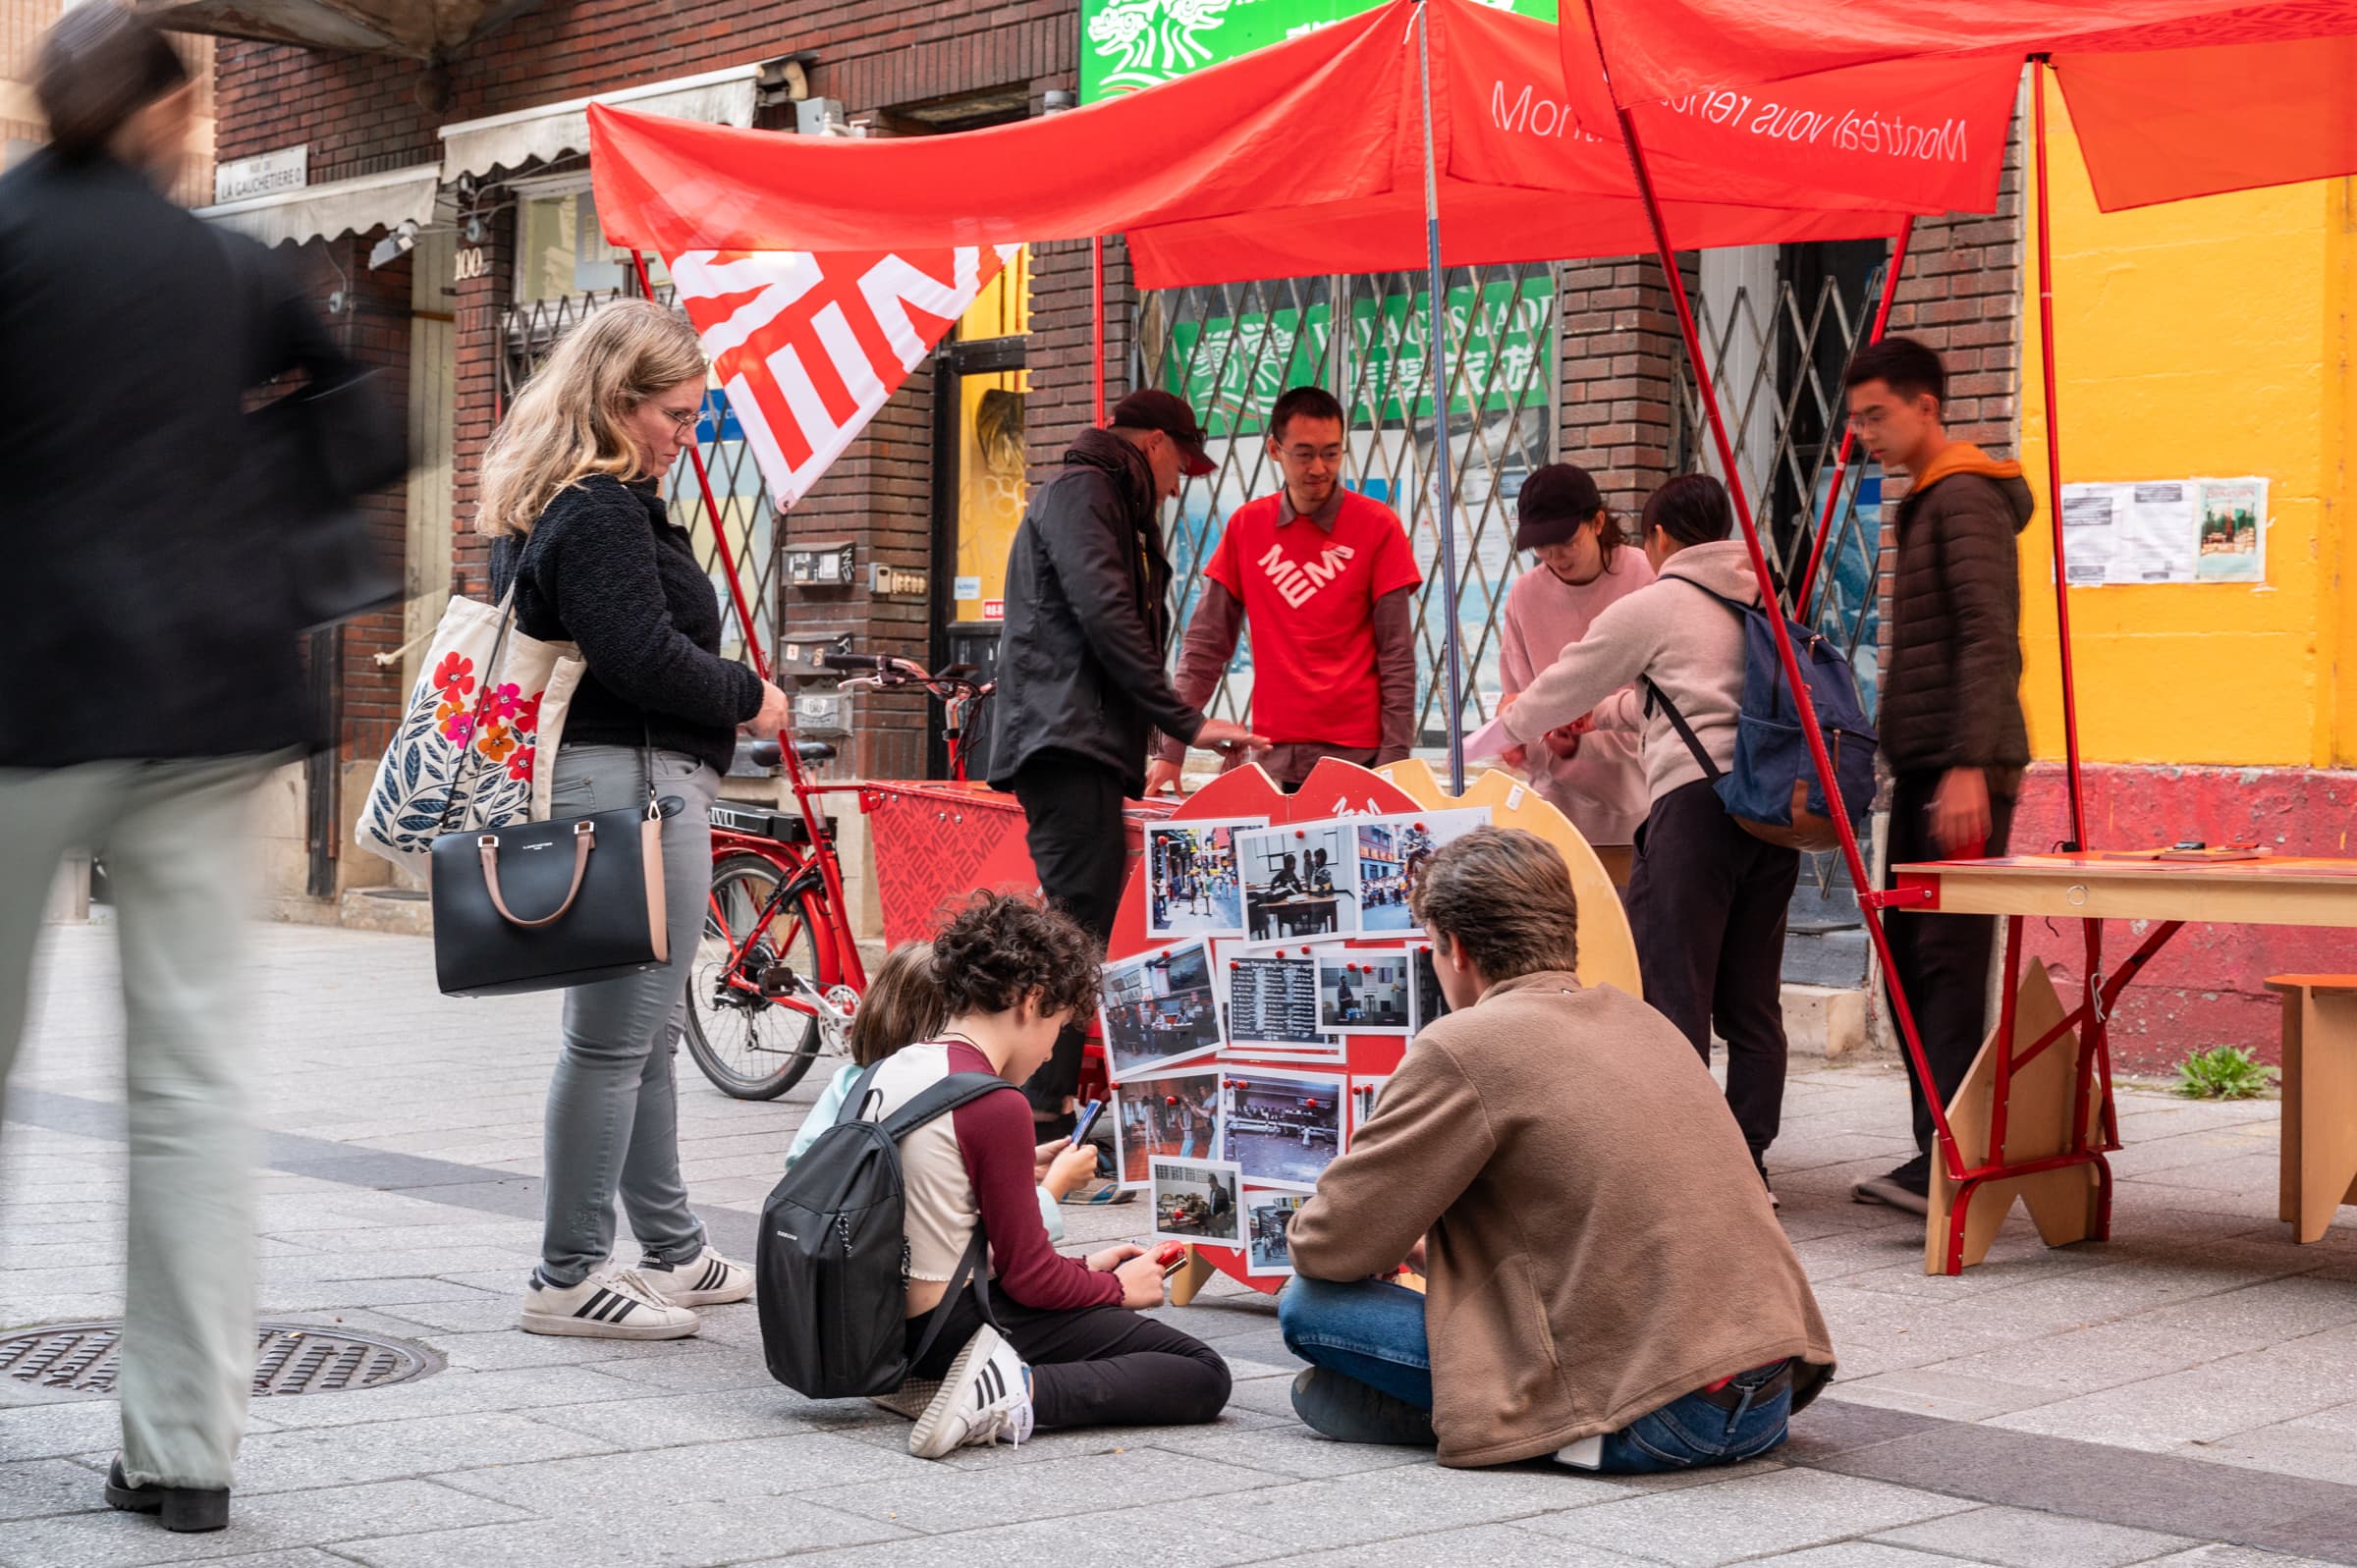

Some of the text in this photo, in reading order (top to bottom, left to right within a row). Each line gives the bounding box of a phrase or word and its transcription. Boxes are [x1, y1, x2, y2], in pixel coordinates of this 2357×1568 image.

[454, 246, 483, 282] 100
[1312, 306, 1466, 354] VYAGS
[1256, 543, 1355, 610] MEM
